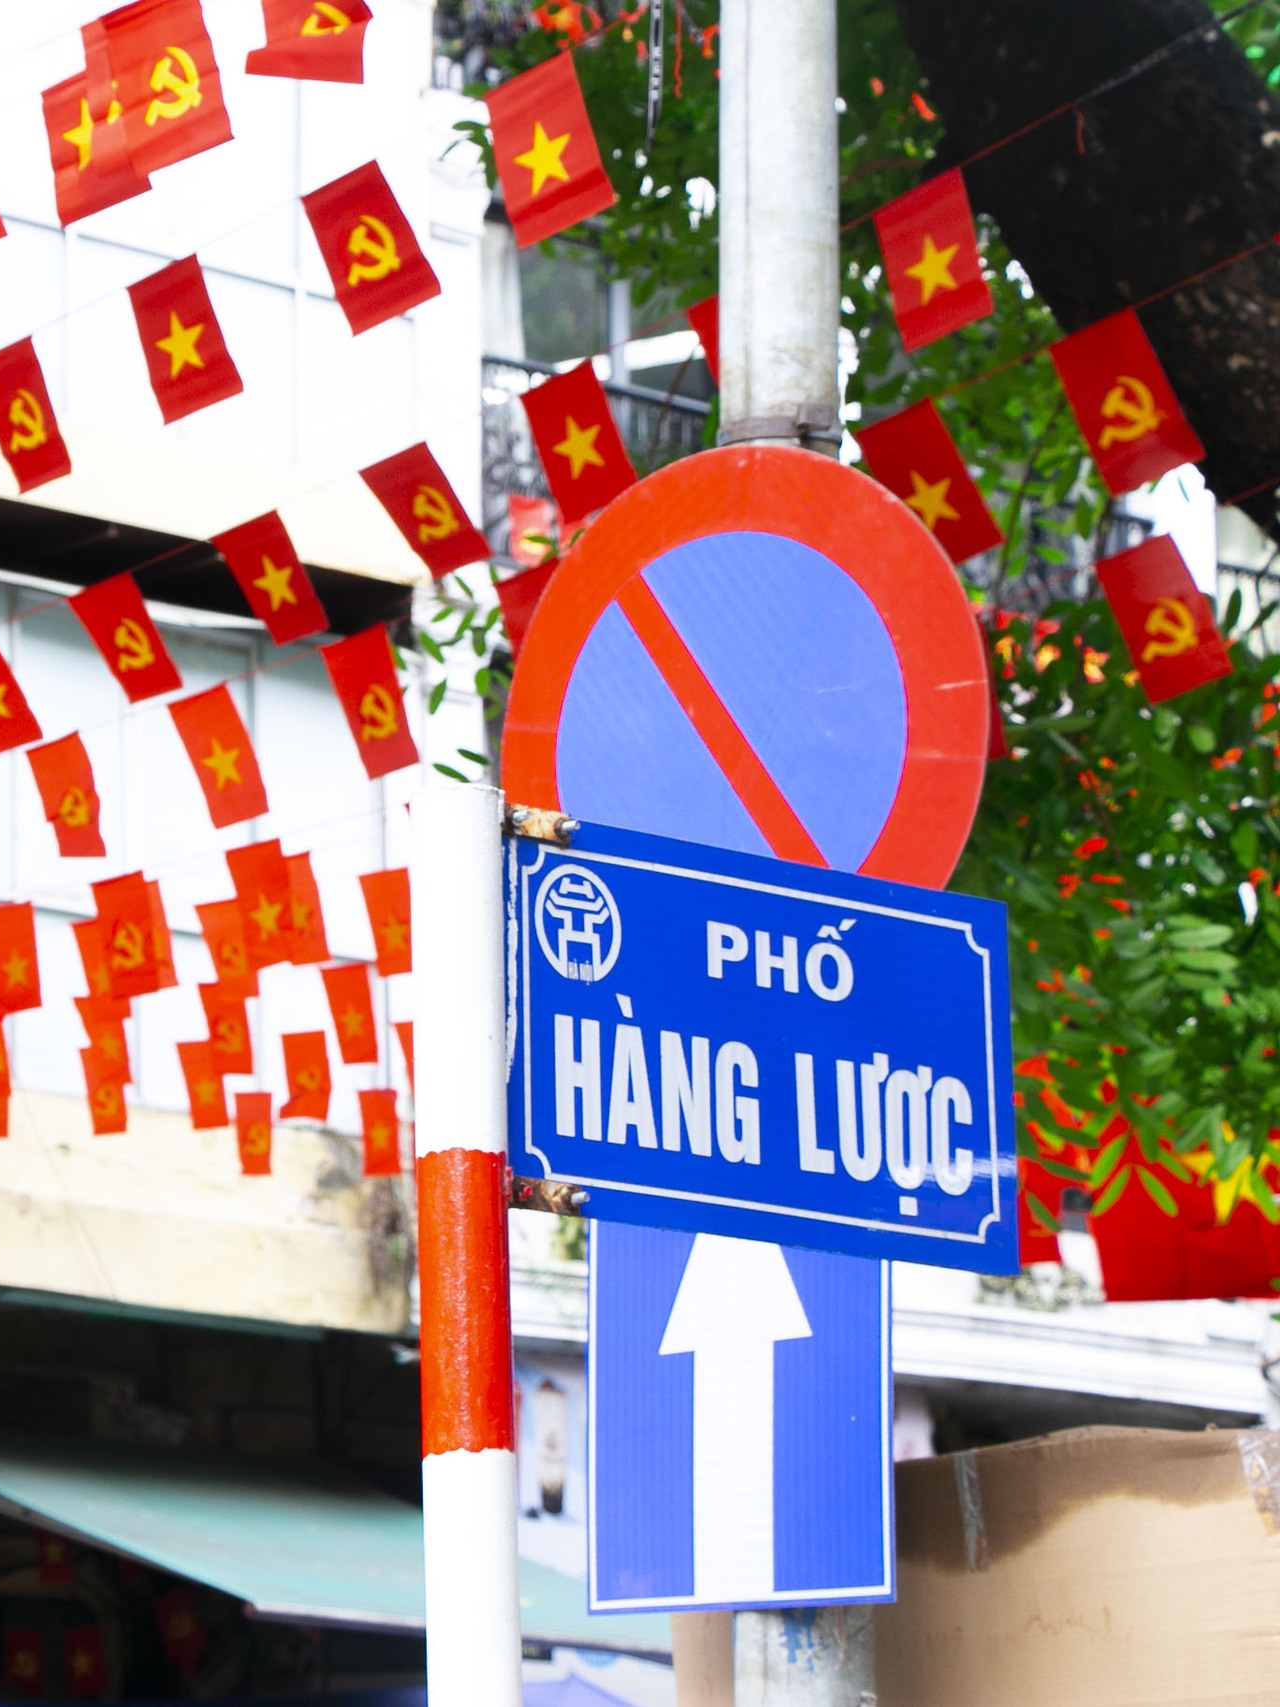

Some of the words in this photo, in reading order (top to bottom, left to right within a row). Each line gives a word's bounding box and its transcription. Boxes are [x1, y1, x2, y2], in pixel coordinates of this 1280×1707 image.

[706, 918, 857, 1002] PHỐ
[554, 993, 761, 1165] HÀNG
[794, 1052, 974, 1216] LƯỢC
